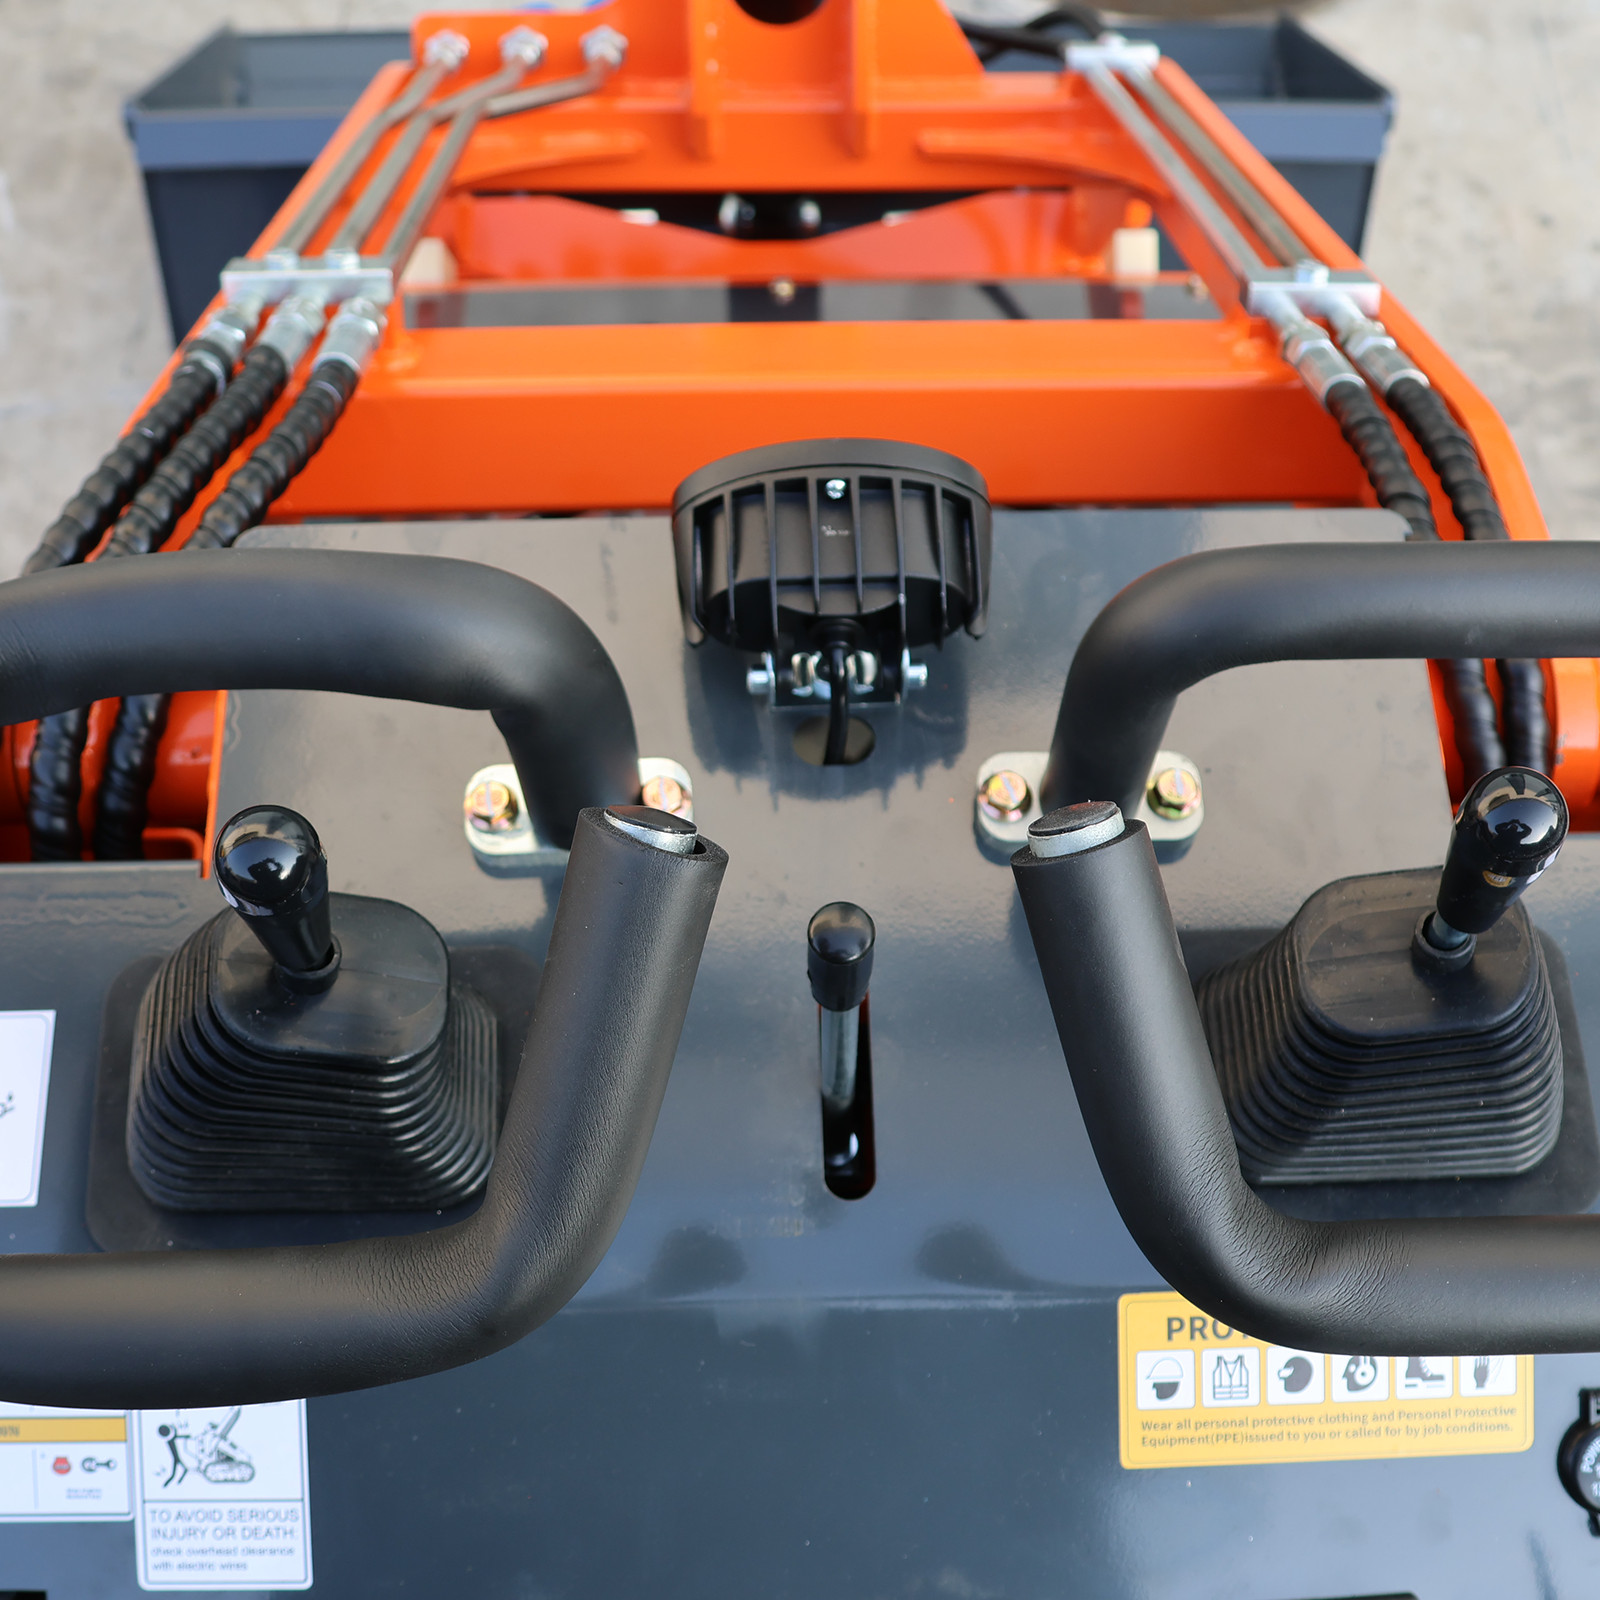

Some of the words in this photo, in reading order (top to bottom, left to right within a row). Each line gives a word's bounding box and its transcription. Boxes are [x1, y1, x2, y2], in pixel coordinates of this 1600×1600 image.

[1167, 1316, 1248, 1341] PRO
[1141, 1420, 1173, 1431] Wear
[1177, 1418, 1191, 1430] all
[1194, 1417, 1249, 1432] personal
[1252, 1414, 1315, 1429] protective
[1318, 1412, 1368, 1425] clothing
[1372, 1410, 1395, 1422] and
[1398, 1408, 1451, 1421] Personal
[1455, 1405, 1517, 1419] Protective
[1141, 1430, 1284, 1448] Equipment(PPE)issued
[1288, 1431, 1300, 1441] to
[1303, 1431, 1326, 1443] you
[1329, 1430, 1341, 1439] or
[1345, 1426, 1382, 1439] called
[1385, 1425, 1402, 1437] for
[1405, 1425, 1420, 1438] by
[1423, 1423, 1443, 1437] job
[1446, 1420, 1513, 1434] conditions.
[150, 1508, 171, 1523] TO
[175, 1508, 224, 1523] AVOID
[227, 1508, 300, 1523] SERIOUS
[151, 1526, 208, 1541] INJURY
[212, 1526, 237, 1541] OR
[152, 1546, 183, 1557] check
[186, 1546, 239, 1557] overhead
[241, 1546, 295, 1556] clearance
[153, 1561, 172, 1571] with
[177, 1561, 216, 1571] electric
[220, 1561, 248, 1571] wires
